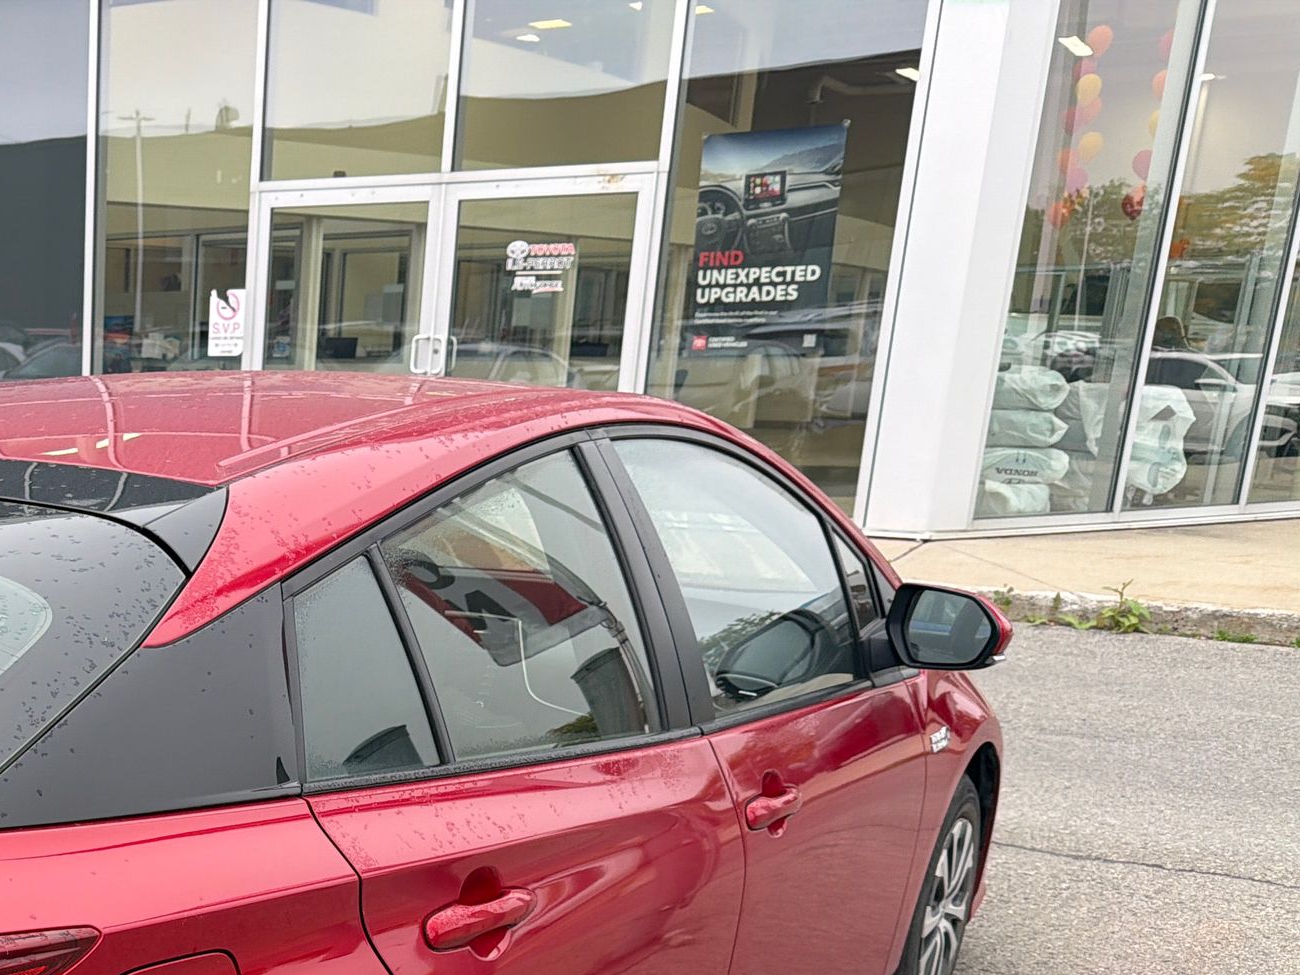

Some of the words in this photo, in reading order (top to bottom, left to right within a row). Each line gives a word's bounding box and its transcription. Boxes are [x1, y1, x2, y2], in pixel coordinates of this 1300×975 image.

[698, 249, 744, 267] FIND
[697, 264, 821, 286] UNEXPECTED
[696, 284, 799, 305] UPGRADES
